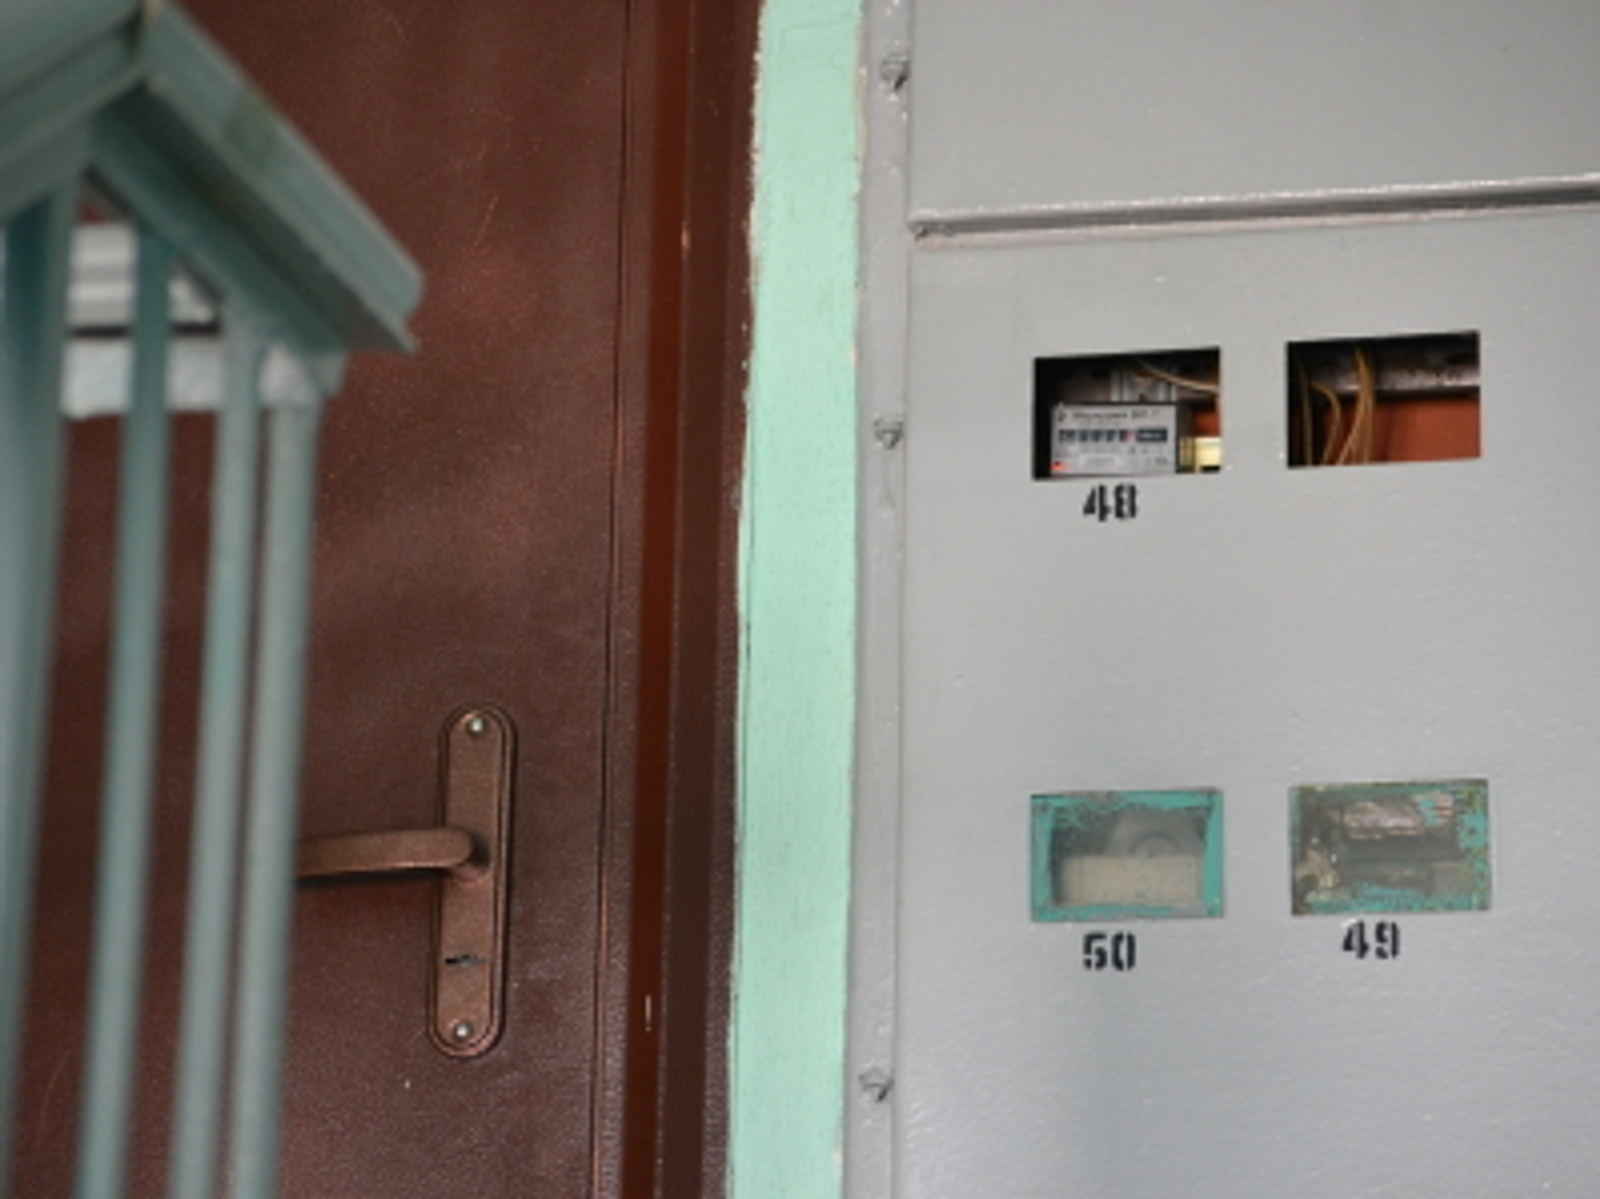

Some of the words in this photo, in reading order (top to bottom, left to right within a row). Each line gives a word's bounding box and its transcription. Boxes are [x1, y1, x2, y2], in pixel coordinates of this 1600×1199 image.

[1082, 484, 1138, 522] 48
[1083, 931, 1136, 972] 50
[1342, 921, 1400, 960] 49
